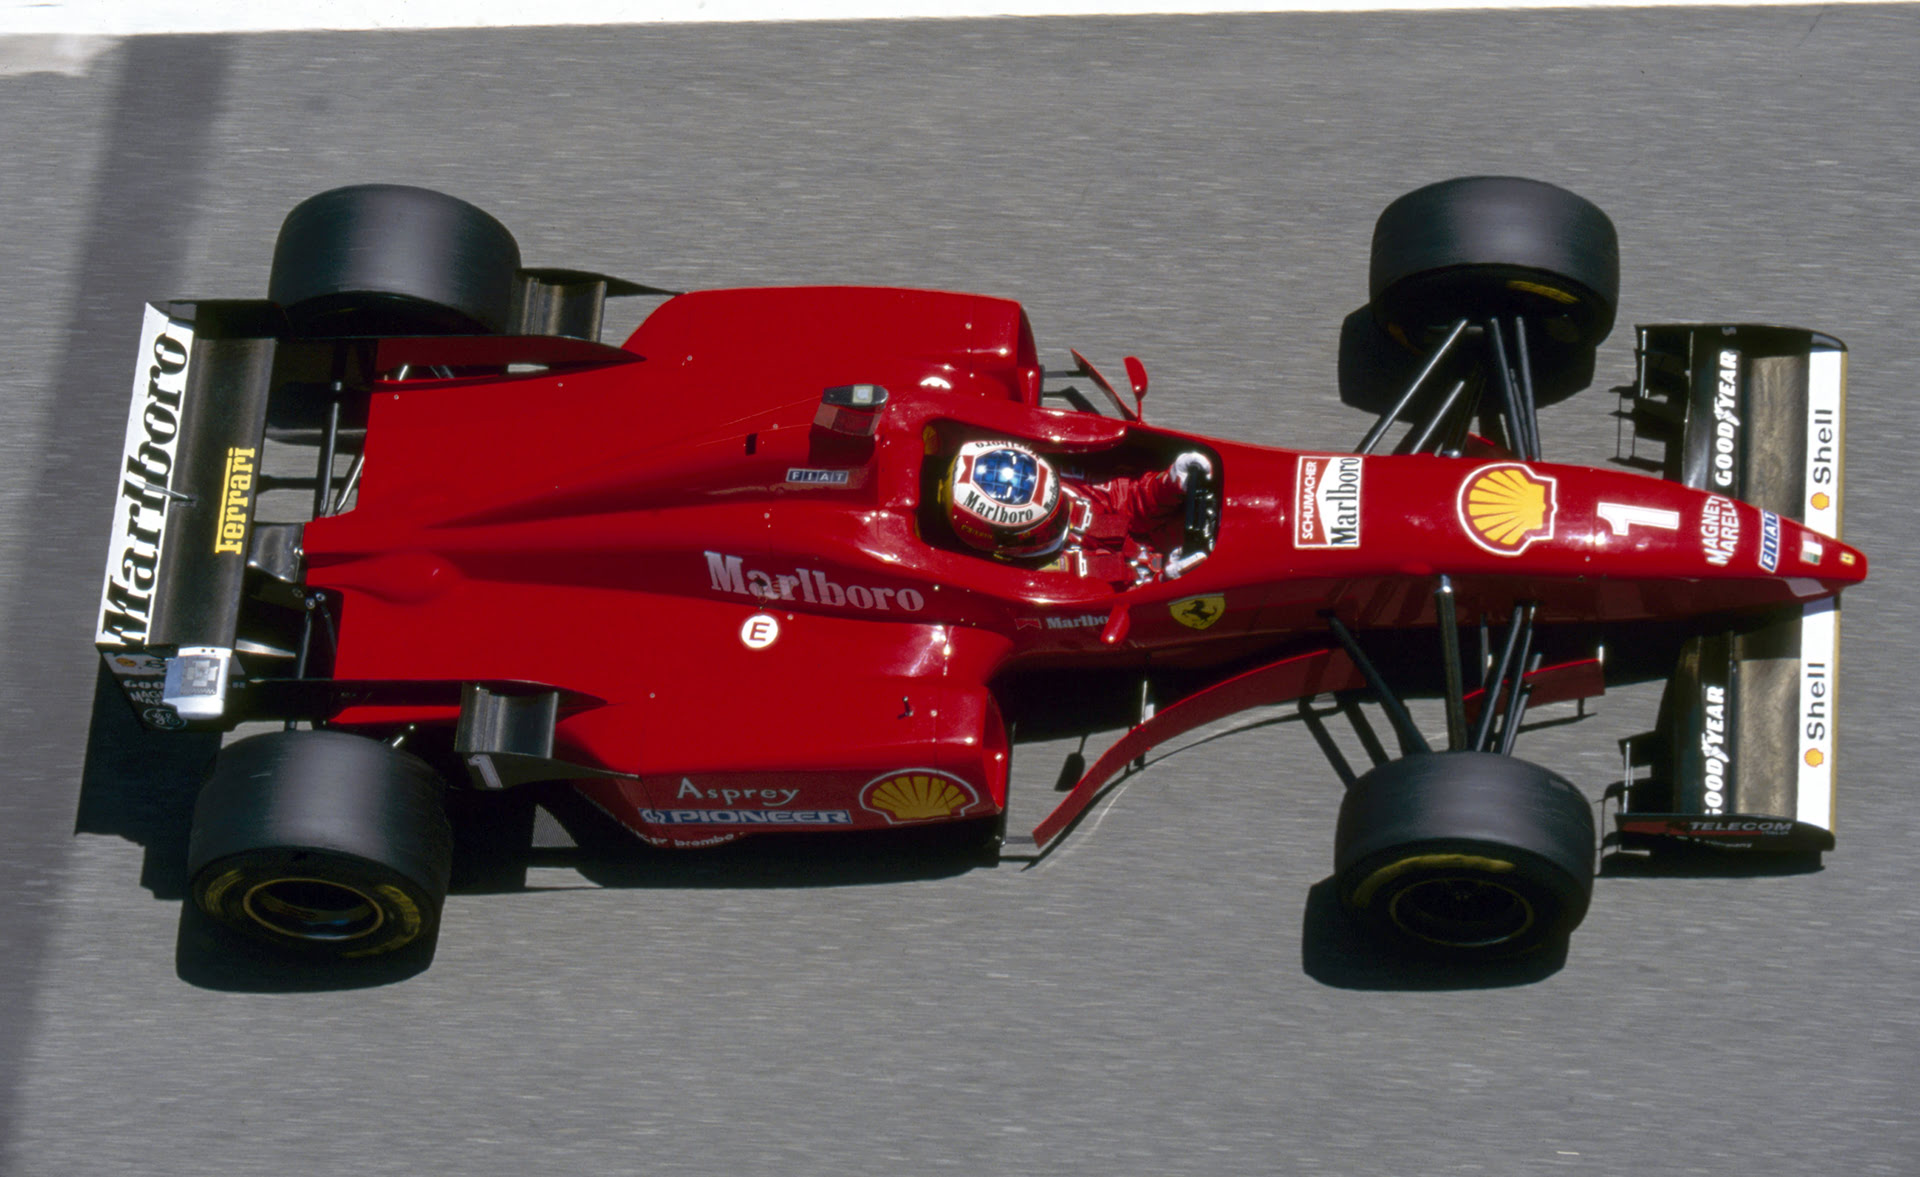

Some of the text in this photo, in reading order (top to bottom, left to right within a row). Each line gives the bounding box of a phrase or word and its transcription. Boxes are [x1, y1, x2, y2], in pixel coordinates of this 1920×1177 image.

[1814, 409, 1833, 484] Shell
[102, 333, 188, 645] Marlboro
[791, 471, 844, 481] FIAT
[215, 447, 255, 554] Ferrari
[963, 490, 1034, 524] Marlboro
[1302, 461, 1317, 540] SCHUMACHER
[1326, 457, 1360, 545] Marlboro
[1597, 502, 1679, 536] 1
[1762, 510, 1777, 567] FIAT
[703, 551, 924, 611] Marlboro
[749, 622, 770, 641] E
[1045, 614, 1110, 629] Marlbo
[1807, 662, 1825, 740] Shell
[676, 777, 800, 806] Asprey
[670, 811, 848, 823] PIONEER
[1689, 821, 1792, 831] TELECOM
[674, 834, 734, 846] brembo
